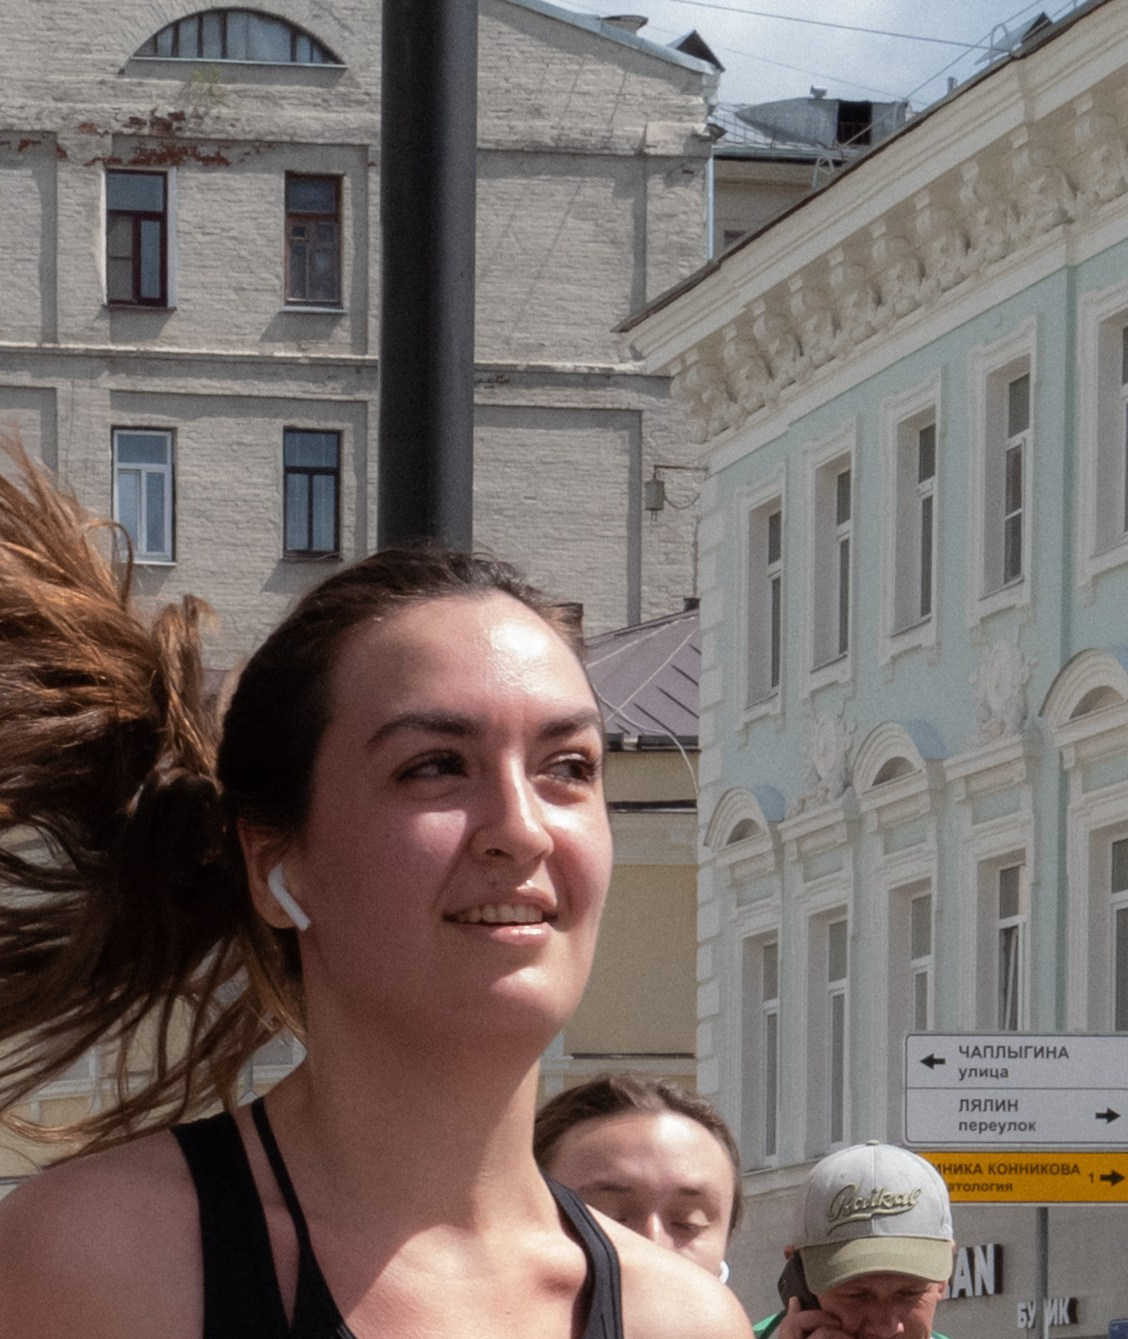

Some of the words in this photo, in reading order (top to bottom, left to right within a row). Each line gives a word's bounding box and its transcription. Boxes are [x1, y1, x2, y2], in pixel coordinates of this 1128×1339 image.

[958, 1045, 1070, 1059] ЧАПЛЫГИНА
[958, 1067, 1009, 1081] улица
[958, 1099, 1019, 1112] ЛЯЛИН
[958, 1121, 1037, 1135] переулок
[987, 1163, 1081, 1175] КОННИКОВА
[1089, 1172, 1095, 1184] 1
[942, 1243, 995, 1299] AN
[1017, 1297, 1071, 1329] БУИК
